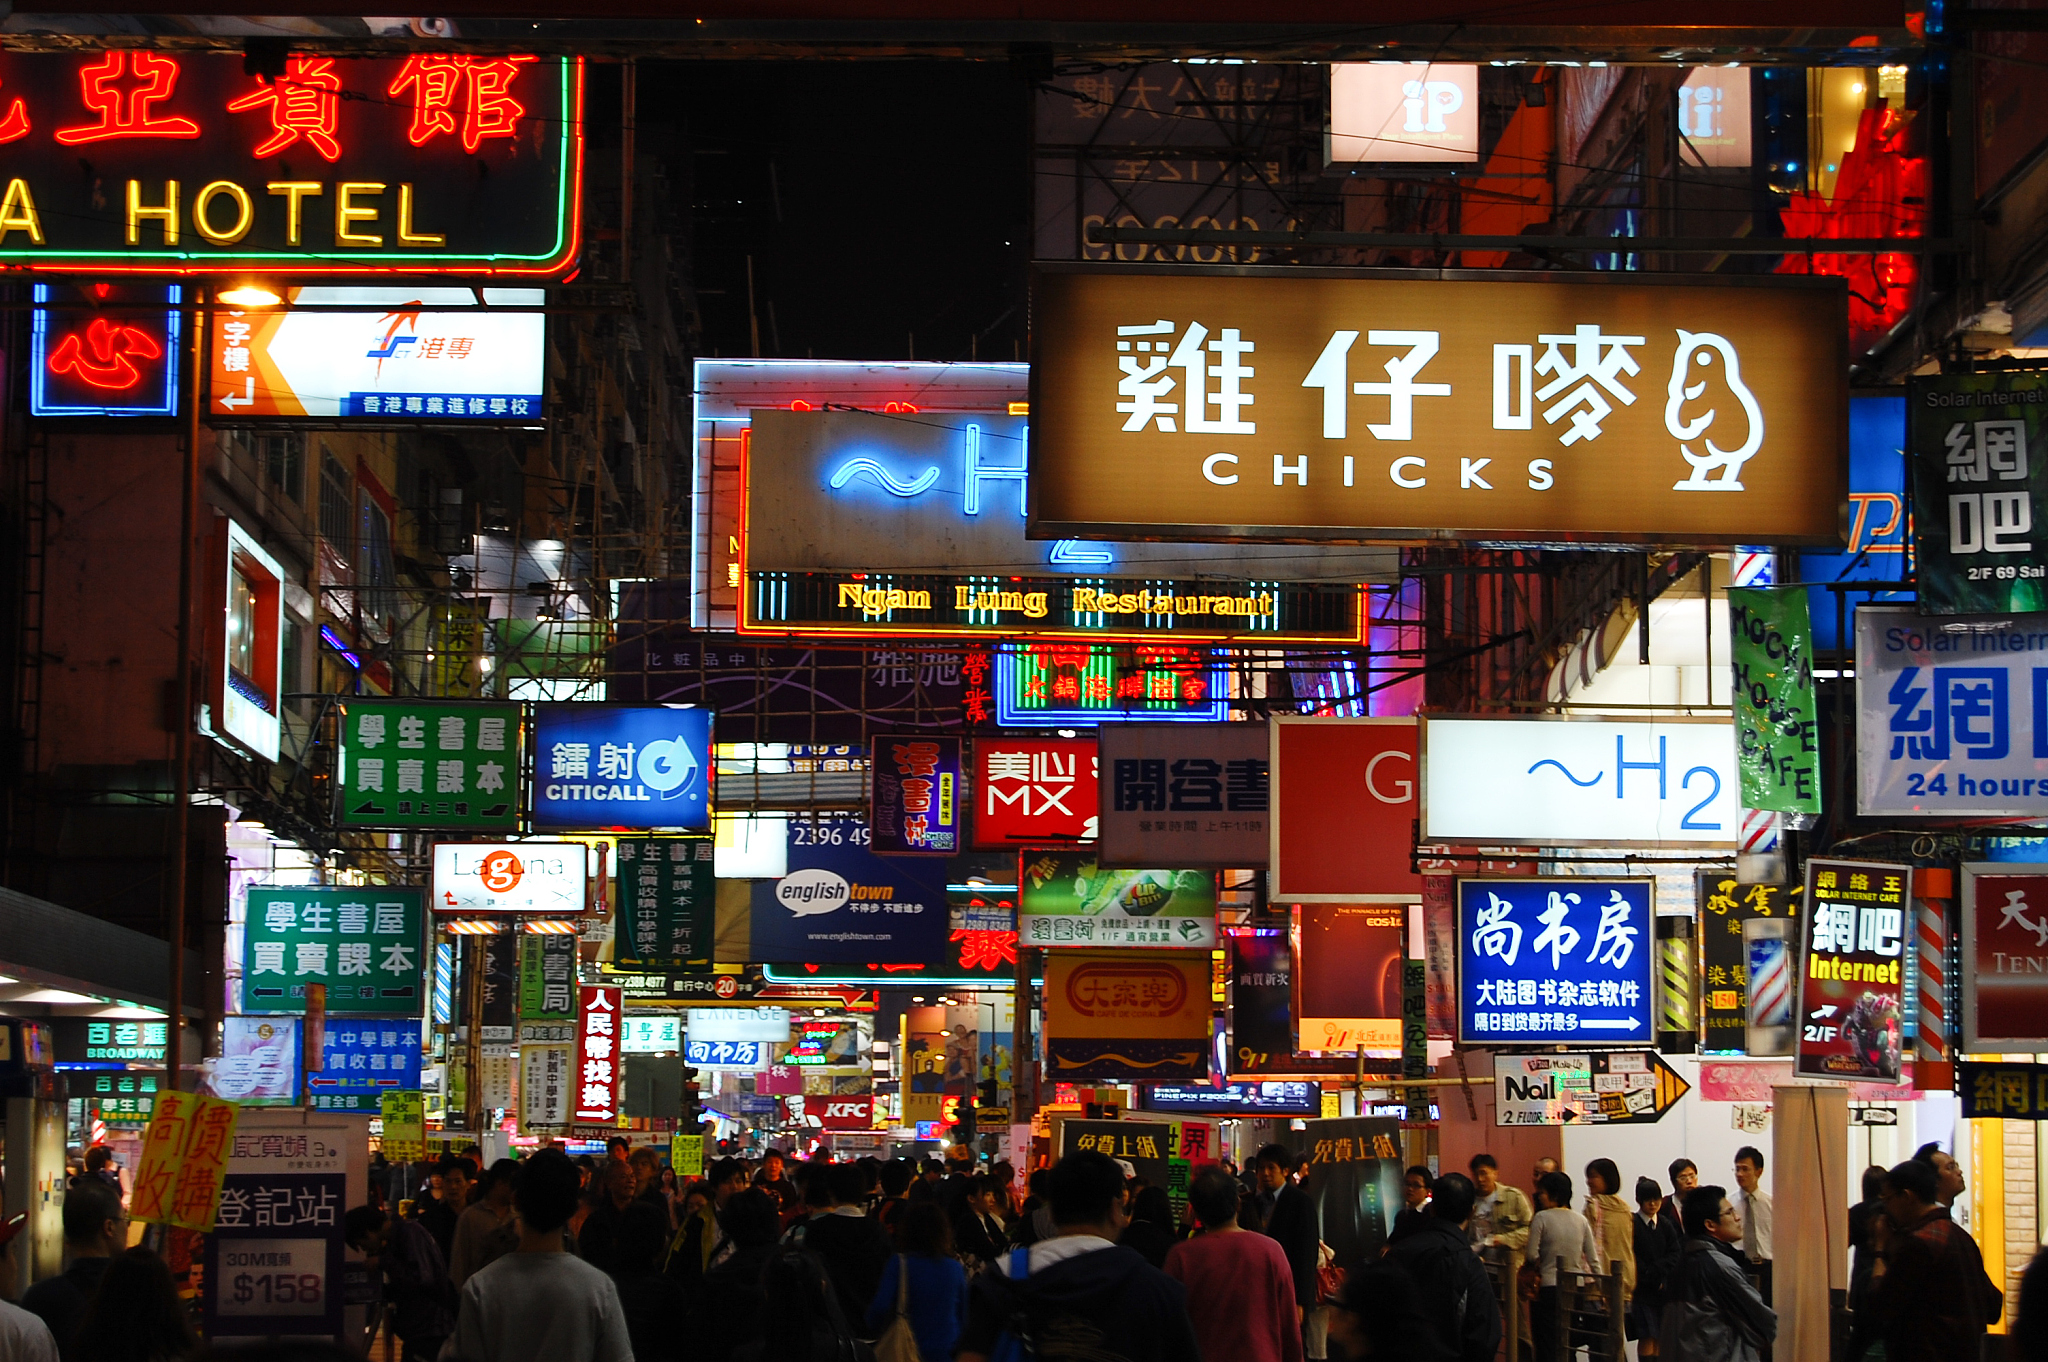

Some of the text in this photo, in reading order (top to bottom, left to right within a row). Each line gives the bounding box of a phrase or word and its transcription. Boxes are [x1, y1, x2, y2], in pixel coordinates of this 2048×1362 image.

[0, 50, 540, 162] 亞賓館
[125, 180, 446, 247] HOTEL
[222, 311, 251, 372] 字樓
[417, 338, 475, 359] 港專
[363, 397, 529, 416] 香港專業進修學校
[1926, 387, 2044, 408] Solar Internet
[1201, 452, 1556, 491] CHICKS
[1944, 420, 2032, 554] 網吧
[1968, 567, 1993, 580] 2/F
[1996, 566, 2017, 579] 69
[838, 584, 1275, 618] Ngan Lung Restaurant
[1885, 627, 1959, 653] Solar
[1888, 667, 2048, 760] 網
[357, 714, 506, 752] 學生書屋
[551, 742, 637, 781] 鐳射
[988, 752, 1076, 782] 美心
[1741, 729, 1812, 800] CAFE
[356, 759, 505, 796] 買賣課本
[1365, 750, 1413, 804] G
[1907, 773, 1948, 796] 24
[545, 784, 650, 801] CITICALL
[892, 742, 940, 847] 漫畫村
[987, 785, 1074, 816] MX
[794, 827, 842, 846] 2396
[1139, 821, 1197, 832] 營業時間
[618, 843, 713, 861] 學生書屋
[454, 852, 563, 889] Laguna
[1817, 871, 1901, 892] 網絡王
[849, 903, 880, 913] 不停步
[1815, 889, 1840, 898] SOLAR
[1842, 891, 1878, 901] INTERNET
[264, 901, 405, 934] 學生書屋
[1472, 891, 1639, 971] 尚书房
[1812, 902, 1902, 956] 網吧
[808, 932, 892, 941] www.englishtown.com
[1102, 932, 1119, 941] 1/F
[251, 942, 414, 977] 買賣課本
[1809, 953, 1900, 985] Internet
[673, 980, 715, 992] 銀行中心
[717, 979, 733, 993] 20
[1083, 978, 1169, 1008] 大家樂
[1475, 979, 1640, 1010] 大陆图书杂志软件
[696, 1009, 781, 1021] LANEIGE
[1474, 1012, 1579, 1033] 隔日到货最齐最多
[581, 989, 615, 1108] 人民幣找換
[1804, 1025, 1838, 1043] 2/F
[87, 1047, 166, 1059] BROADWAY
[322, 1053, 406, 1070] 價收舊書
[1505, 1075, 1556, 1102] Nail
[1601, 1076, 1623, 1087] 美甲
[824, 1103, 869, 1118] KFC
[1503, 1110, 1543, 1123] 2 FLOOR
[1077, 1133, 1160, 1159] 免費上網
[1311, 1134, 1398, 1165] 免費上網
[214, 1185, 338, 1228] 登記站
[234, 1272, 321, 1304] $158
